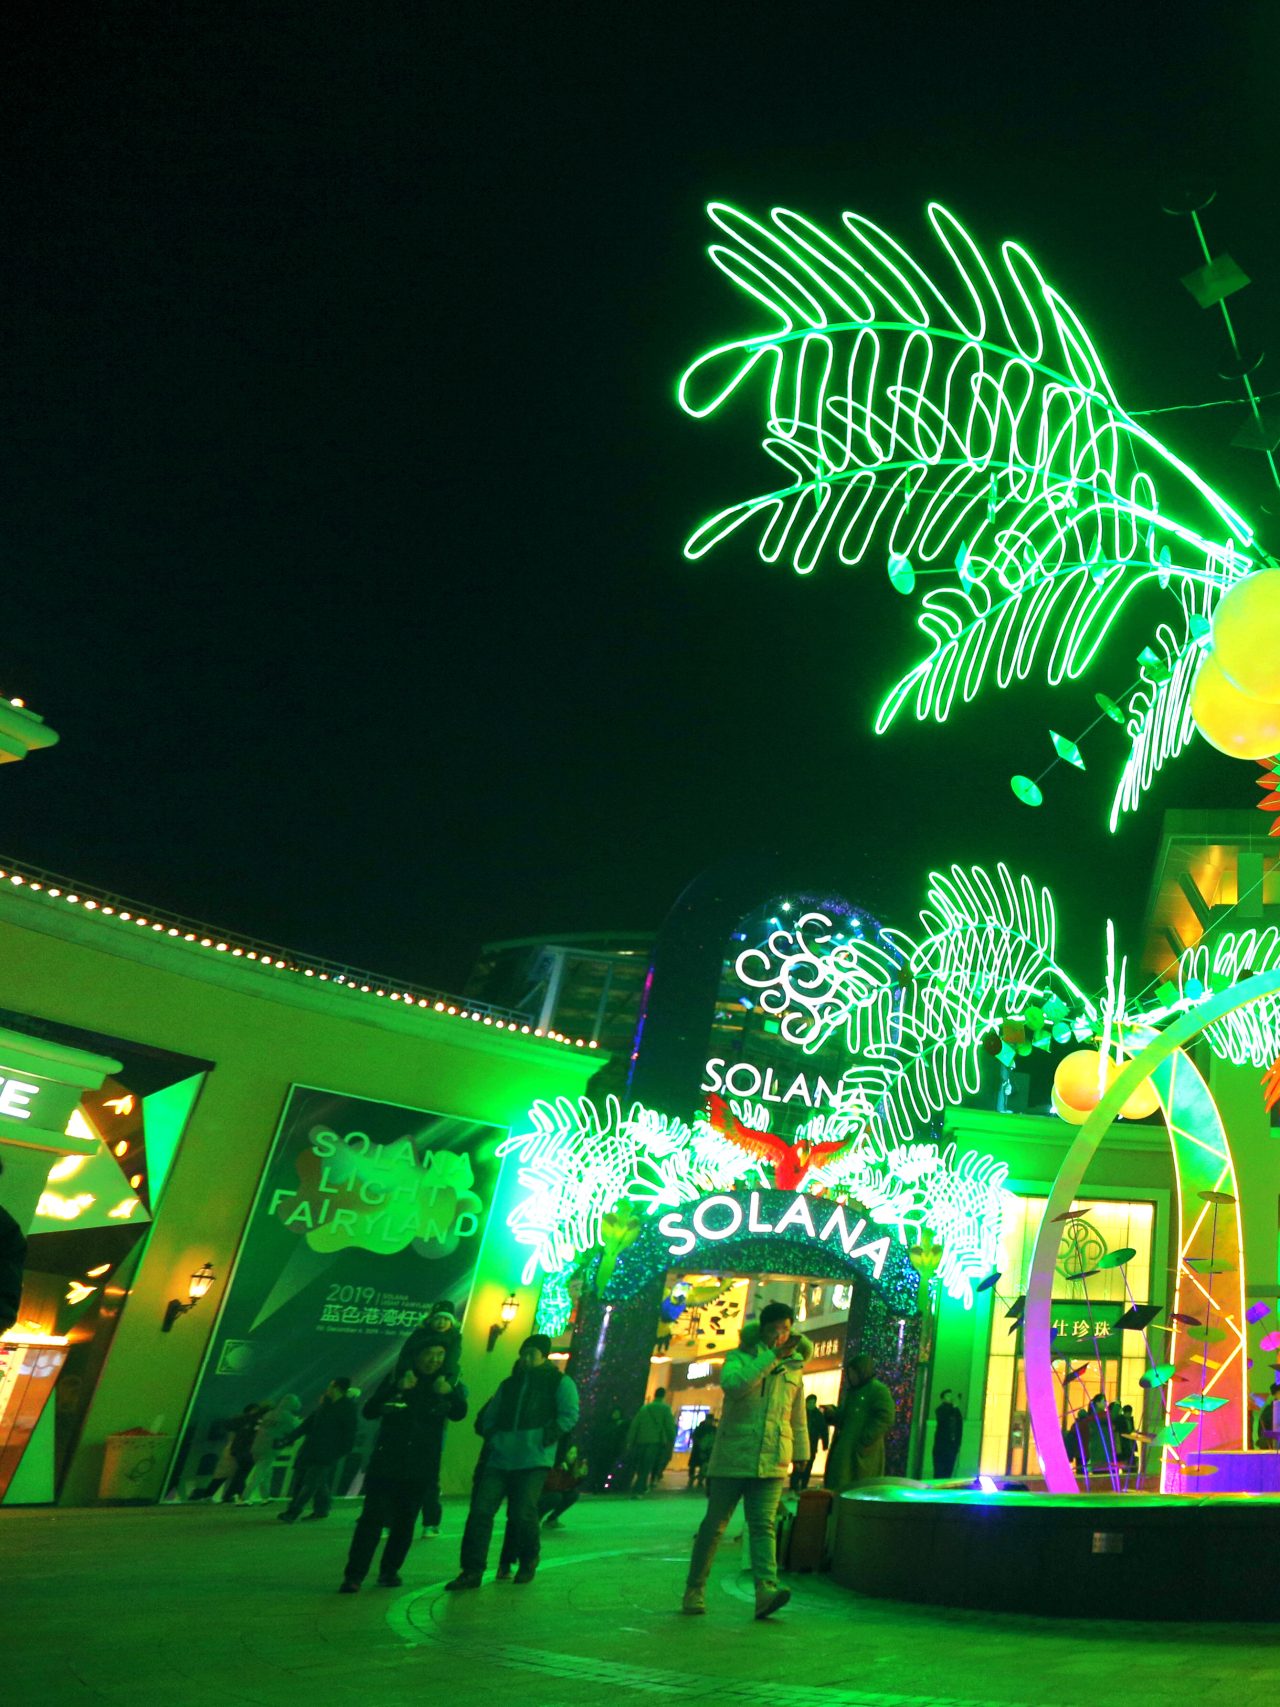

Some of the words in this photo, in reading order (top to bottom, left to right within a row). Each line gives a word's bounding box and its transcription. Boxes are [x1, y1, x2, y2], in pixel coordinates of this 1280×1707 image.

[701, 1058, 874, 1113] SOLANA
[312, 1131, 471, 1174] SOLANA
[318, 1165, 447, 1208] LIGHT
[267, 1188, 479, 1246] FAIRYLAND
[658, 1191, 891, 1280] SOLANA
[326, 1284, 376, 1304] 2019
[1052, 1319, 1111, 1338] 仕珍珠
